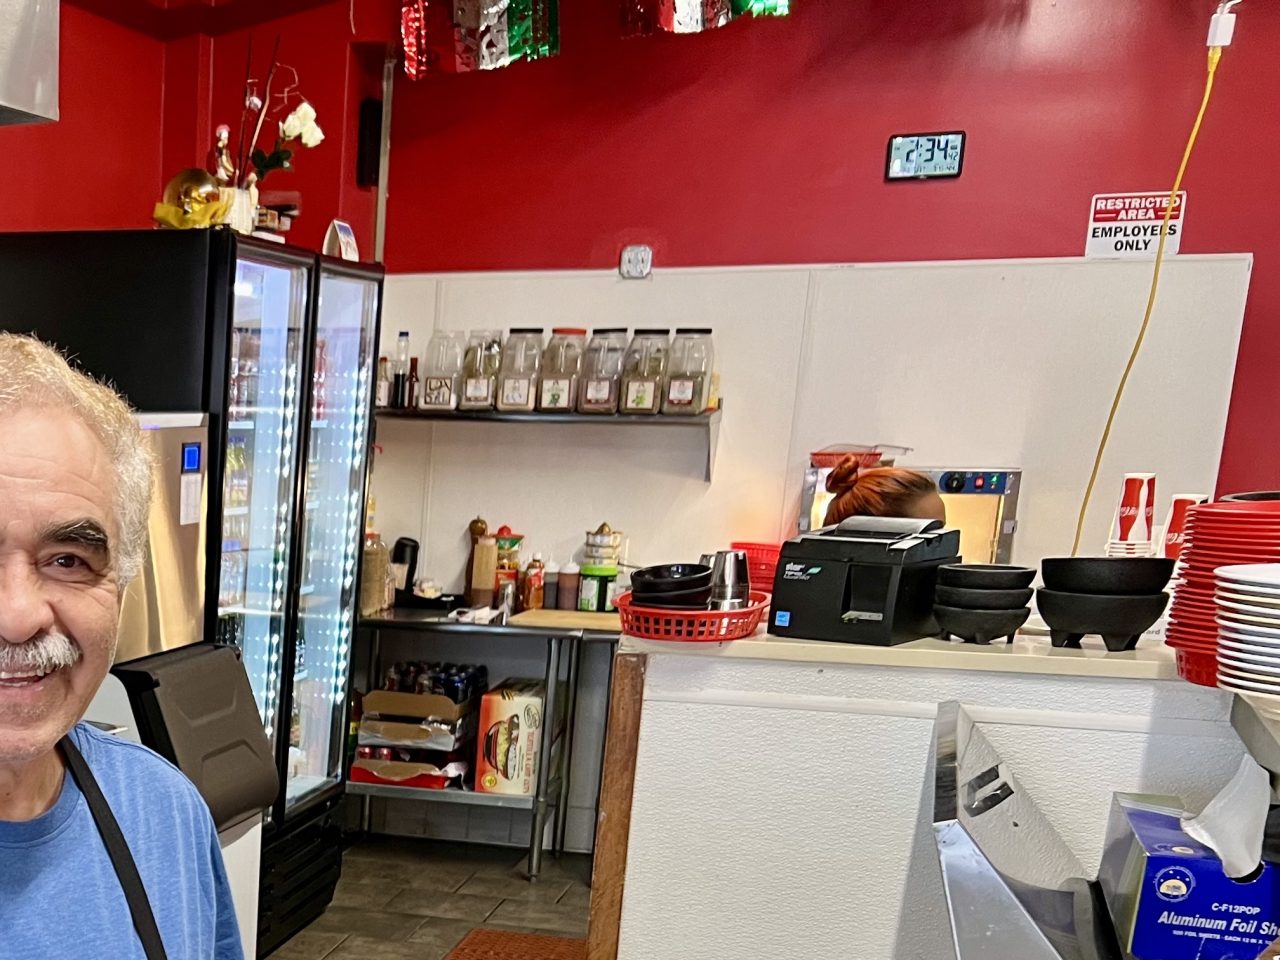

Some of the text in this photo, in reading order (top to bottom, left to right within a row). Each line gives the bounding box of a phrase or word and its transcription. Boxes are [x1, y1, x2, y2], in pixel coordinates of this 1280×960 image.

[906, 138, 949, 162] 2:34
[1096, 197, 1180, 210] RESTRICTED
[1117, 208, 1156, 221] AREA
[1114, 239, 1151, 251] ONLY
[1211, 902, 1261, 915] C-F12POP
[1157, 911, 1227, 931] Aluminum
[1229, 918, 1257, 934] Foil
